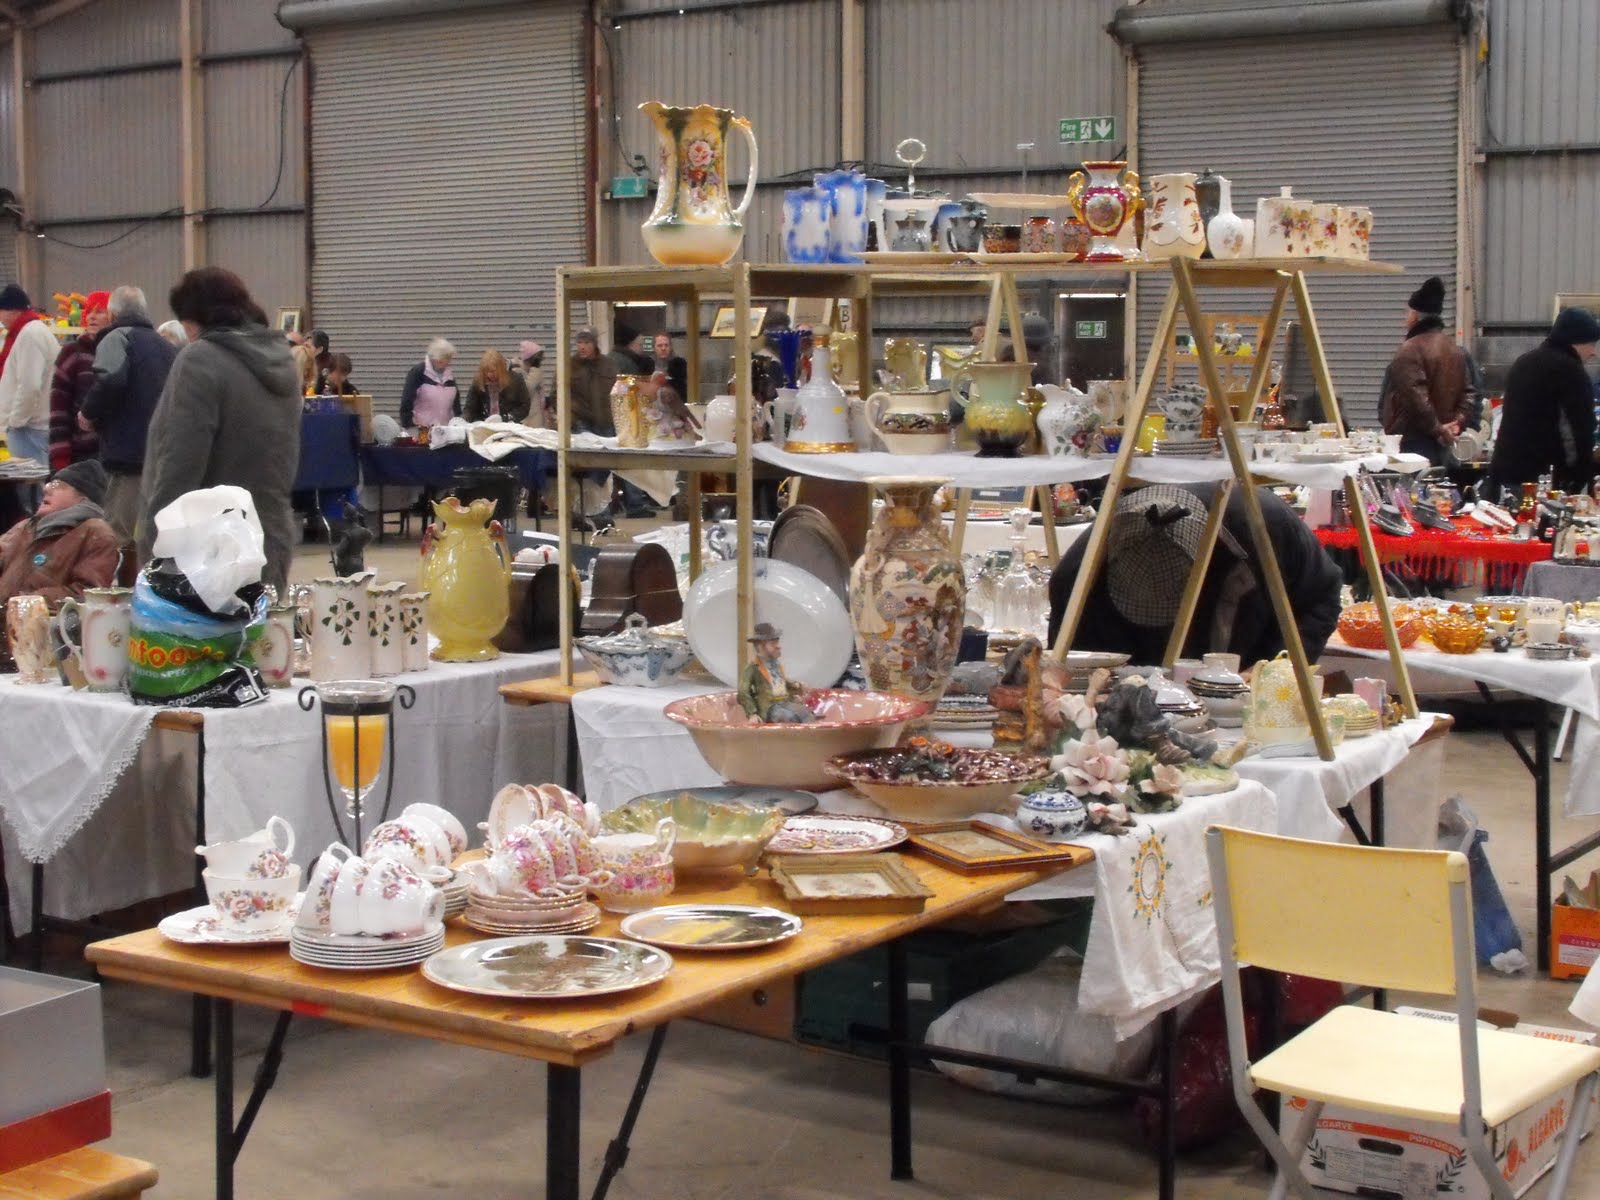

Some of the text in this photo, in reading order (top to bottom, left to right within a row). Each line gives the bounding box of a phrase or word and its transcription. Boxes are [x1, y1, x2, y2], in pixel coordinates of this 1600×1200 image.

[1061, 123, 1077, 131] Fire
[1061, 131, 1077, 140] exit
[1412, 1010, 1457, 1023] PORTUGAL
[1534, 1030, 1576, 1043] ALGARVE
[1315, 1120, 1354, 1132] LGARVE
[1528, 1097, 1565, 1153] ALGARVE
